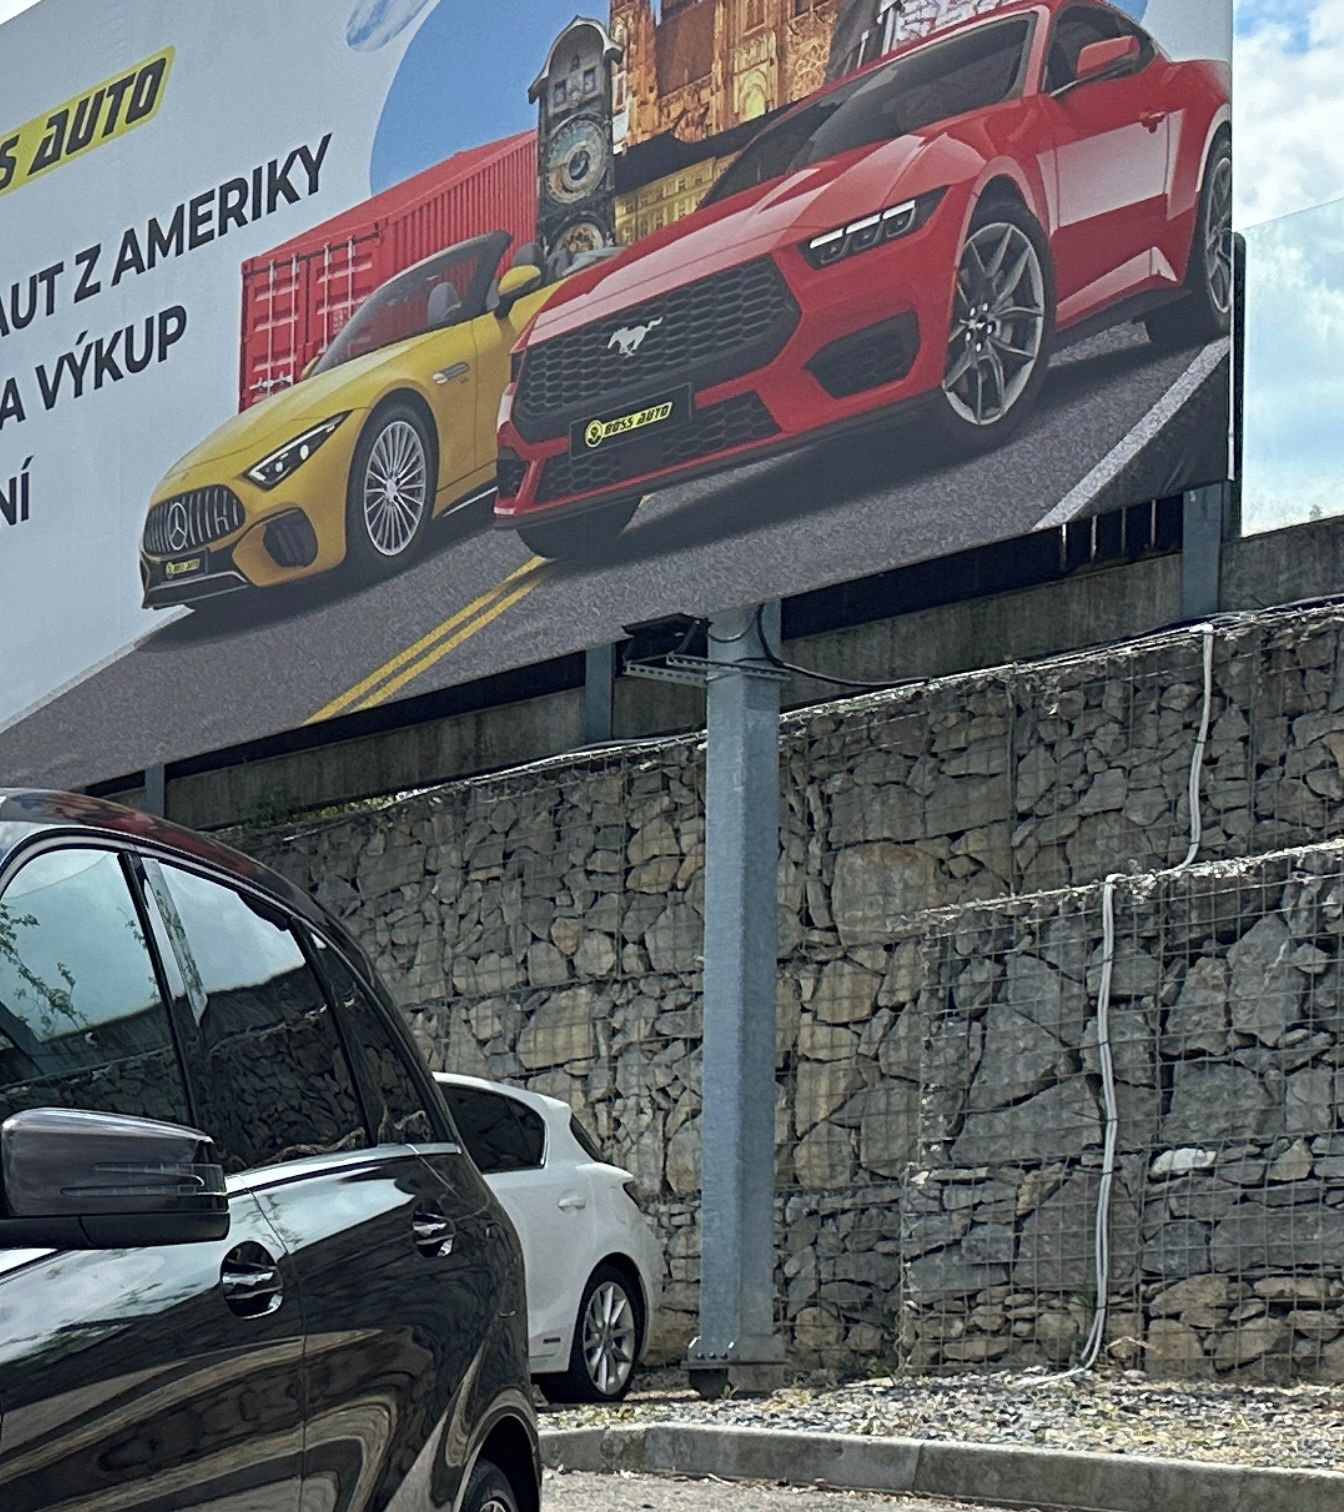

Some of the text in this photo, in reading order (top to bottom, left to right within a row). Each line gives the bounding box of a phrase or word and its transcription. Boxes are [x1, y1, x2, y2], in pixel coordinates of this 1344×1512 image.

[28, 57, 168, 175] AUTO
[74, 243, 102, 303] Z
[111, 133, 333, 286] AMERIKY
[36, 304, 188, 410] VÝKUP
